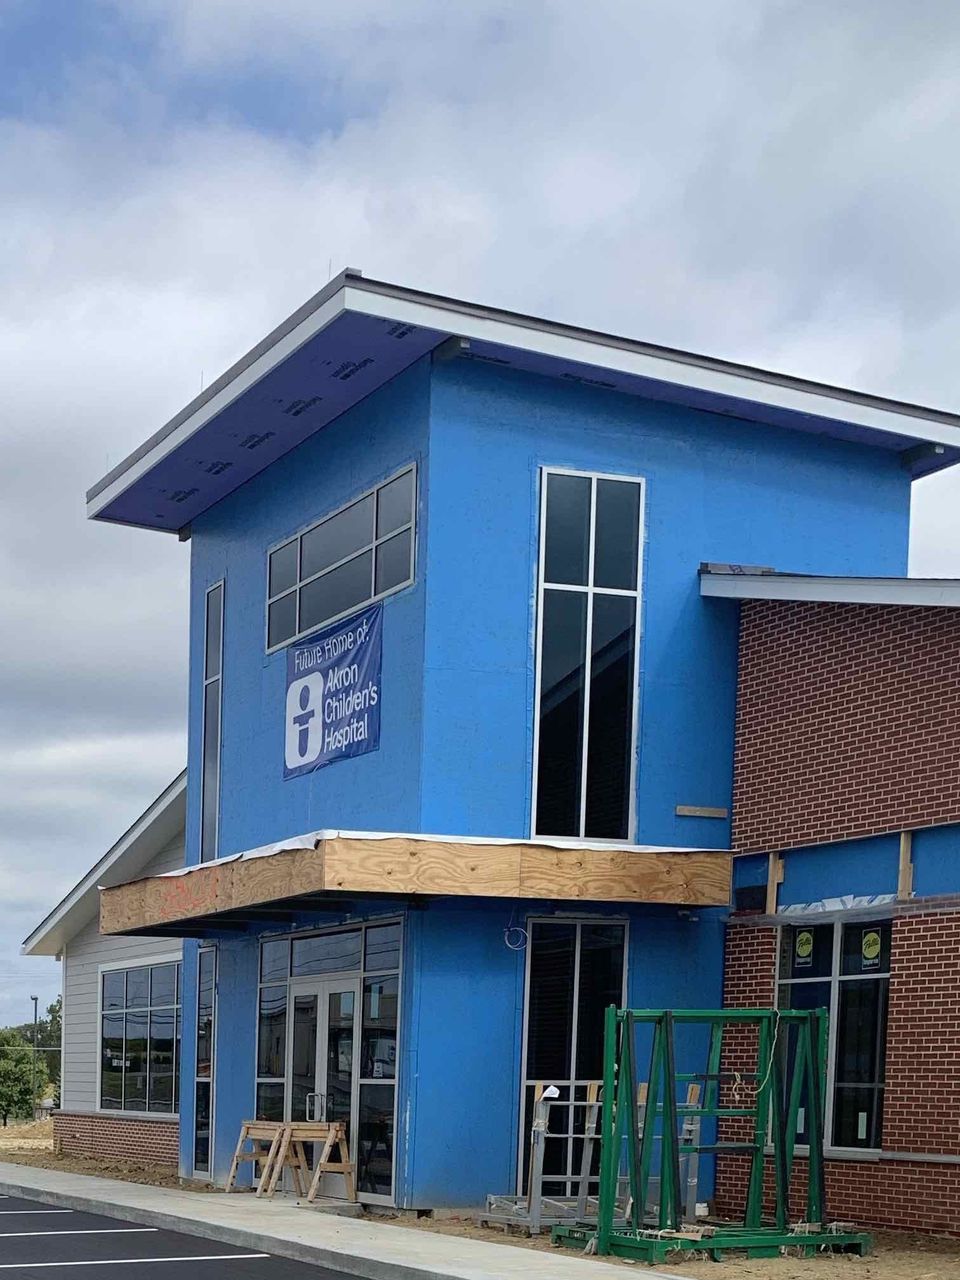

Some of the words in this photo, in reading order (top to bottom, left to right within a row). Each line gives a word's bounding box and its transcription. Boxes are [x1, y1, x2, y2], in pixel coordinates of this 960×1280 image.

[294, 646, 323, 674] Future
[324, 632, 354, 660] Home
[325, 663, 359, 695] Akron
[324, 681, 379, 724] Children's
[324, 713, 369, 753] Hospital
